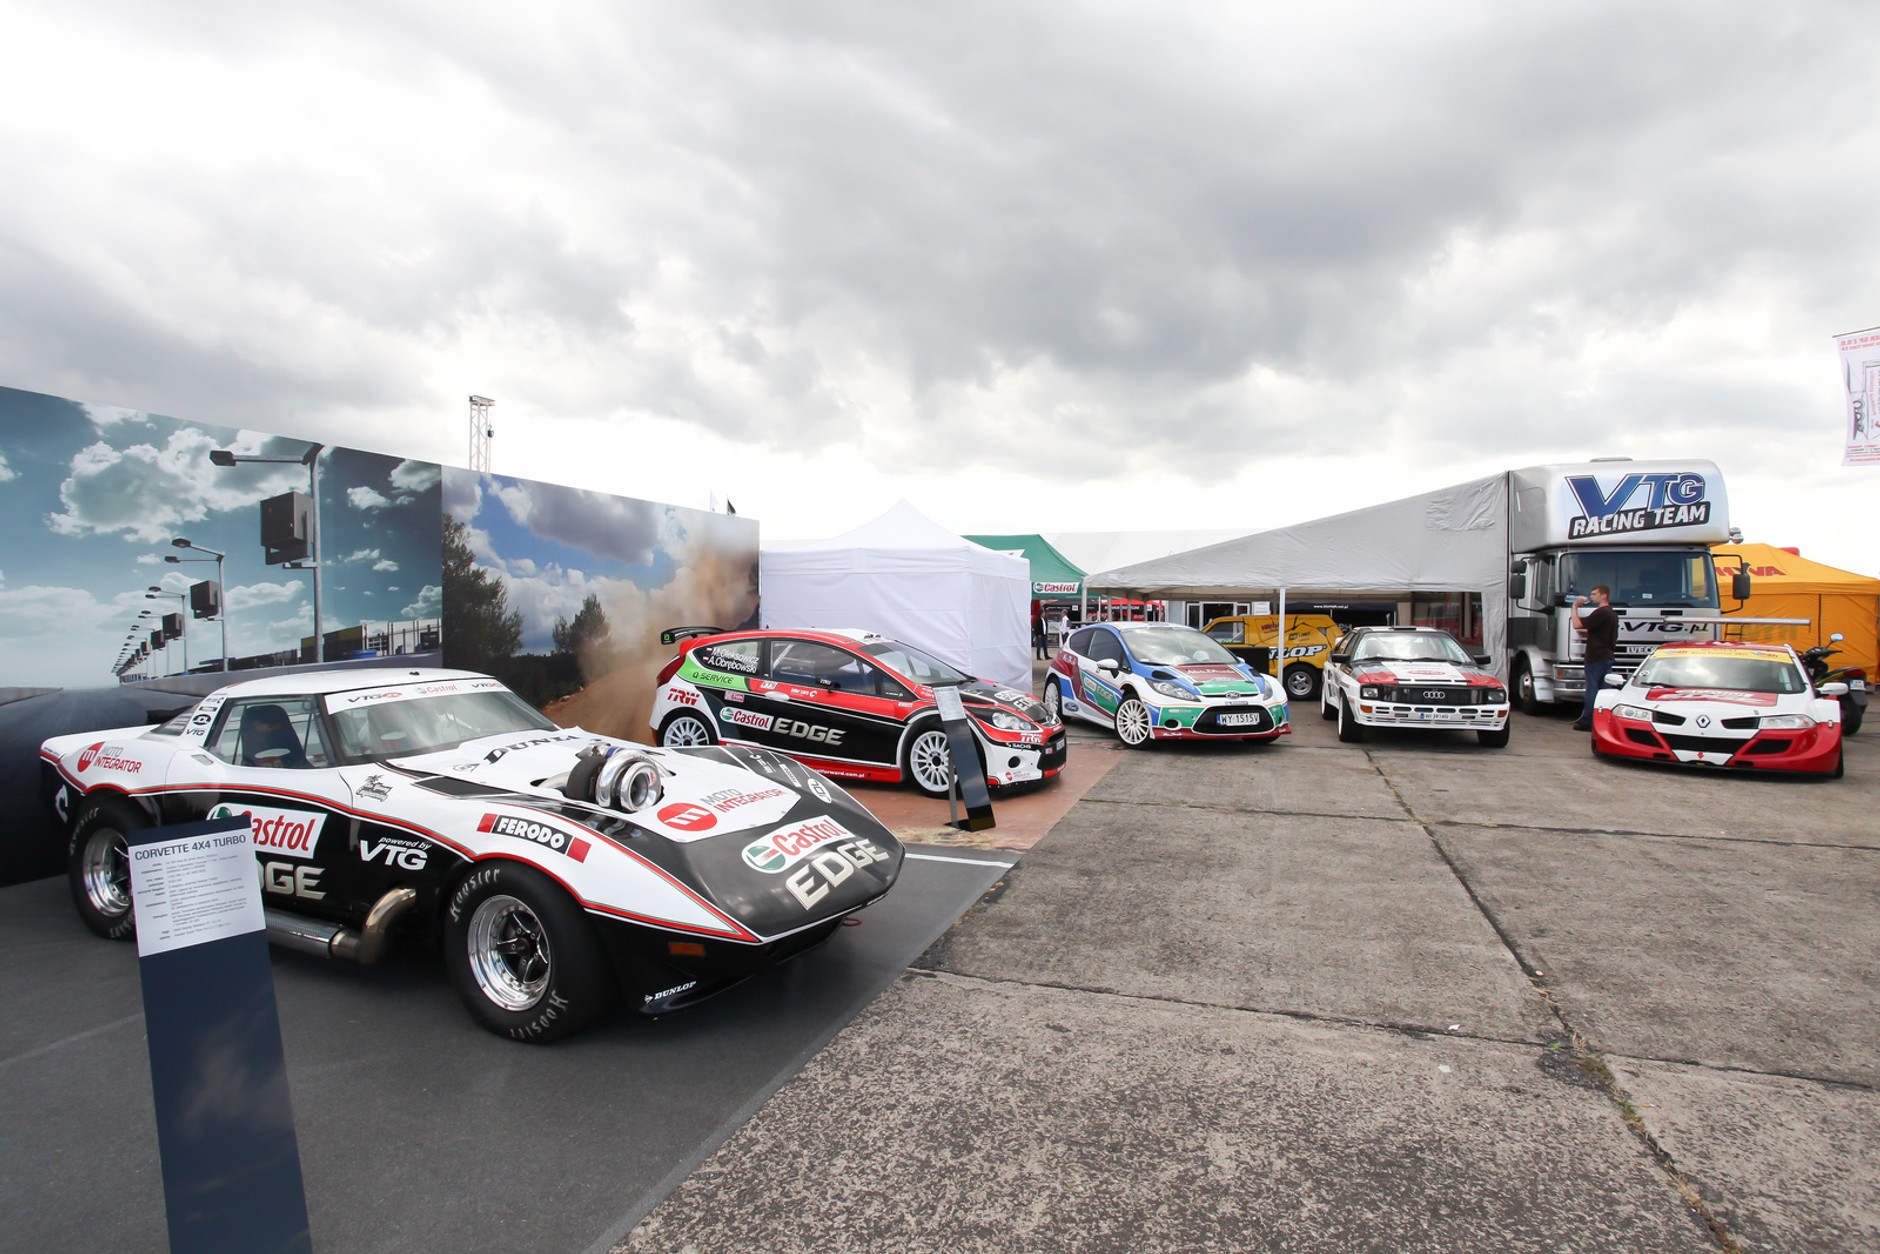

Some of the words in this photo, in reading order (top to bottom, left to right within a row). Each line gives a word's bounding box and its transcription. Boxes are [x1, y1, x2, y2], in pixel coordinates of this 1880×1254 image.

[1564, 472, 1706, 520] VTG
[1572, 510, 1645, 536] RACING
[1654, 505, 1706, 526] TEAM
[1044, 583, 1076, 592] Castrol
[426, 684, 458, 693] Castrol
[700, 673, 735, 684] SERVICE
[668, 687, 700, 706] TRW
[733, 711, 770, 729] Castrol
[772, 717, 847, 746] EDGE
[483, 734, 580, 765] DUNL
[1020, 733, 1042, 743] TRW
[102, 746, 124, 756] MOTO
[94, 756, 143, 774] INTEGRATOR
[700, 788, 742, 806] MOTO
[712, 788, 785, 813] INTEGRATOR
[240, 810, 316, 851] astrol
[497, 818, 565, 849] FERODO
[772, 818, 848, 857] Castrol
[135, 843, 190, 861] CORVETTE
[192, 840, 211, 852] 4X4
[212, 834, 246, 848] TURBO
[360, 839, 428, 871] VTG
[378, 837, 419, 848] powered
[418, 841, 432, 850] by
[256, 861, 327, 900] GE
[785, 838, 890, 911] EDGE
[654, 981, 697, 1000] DUNLOP
